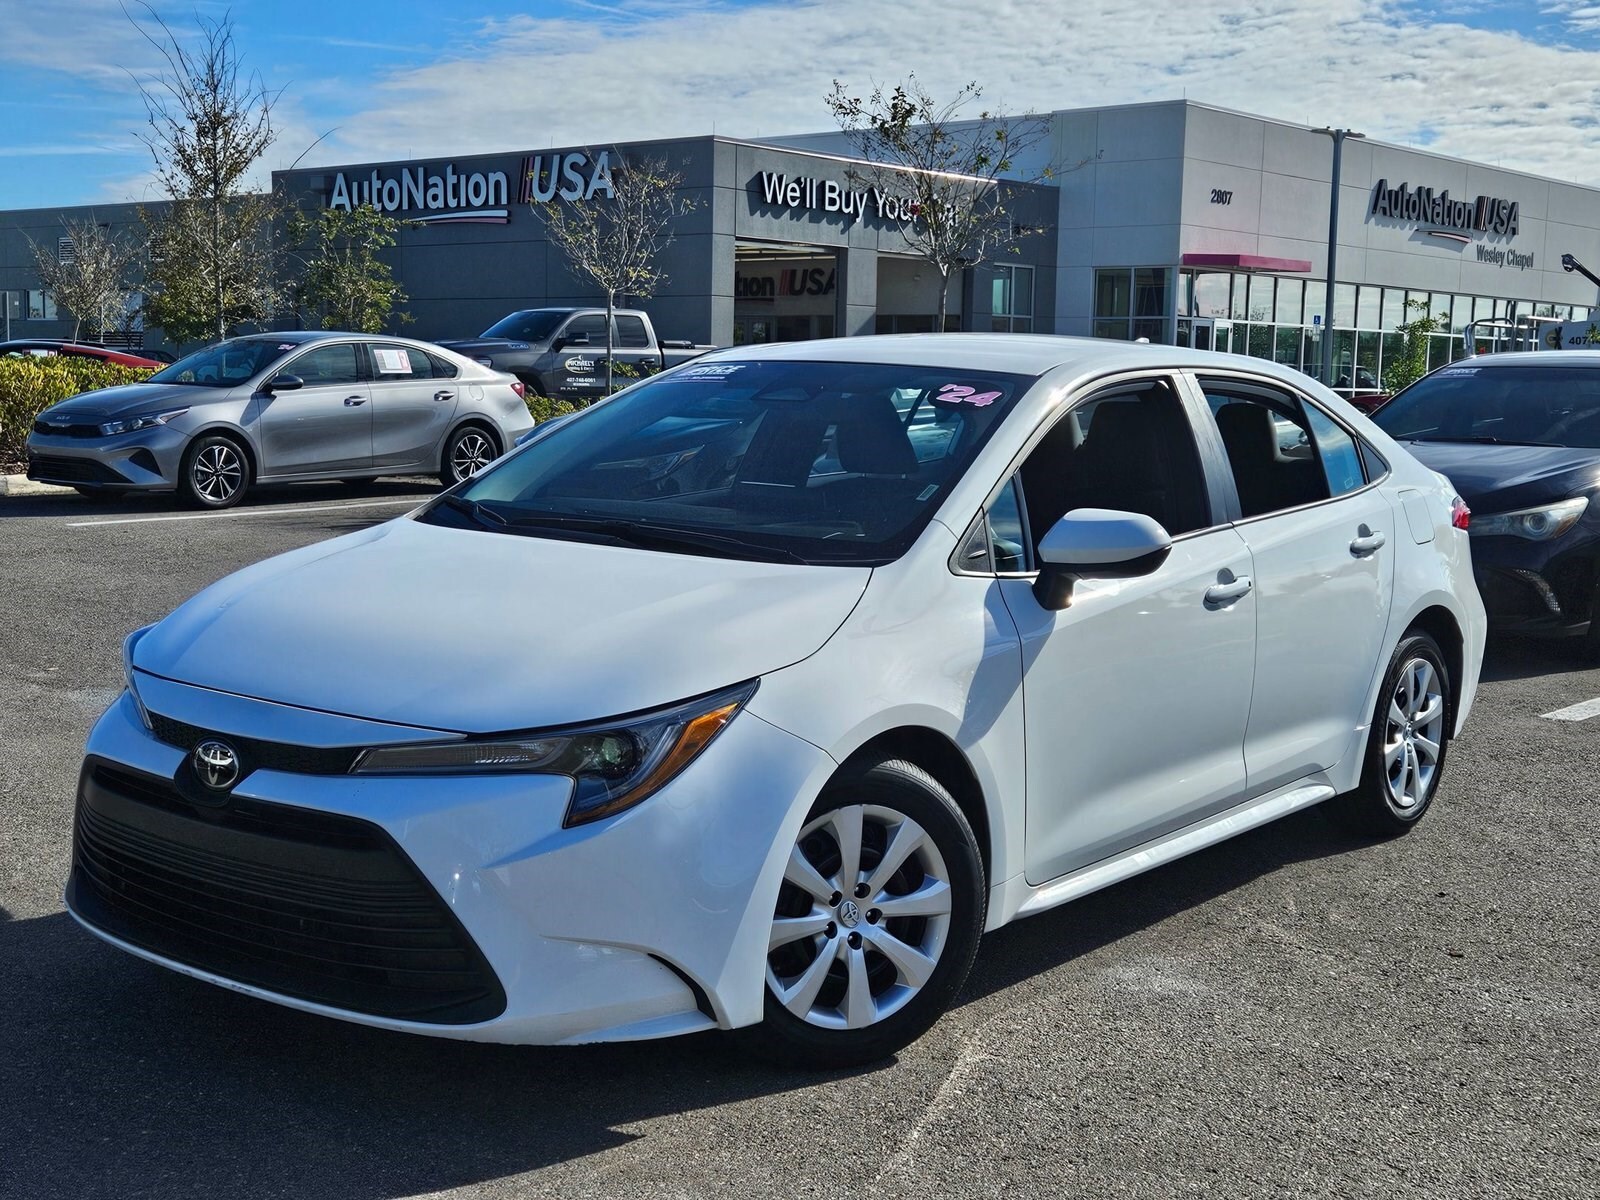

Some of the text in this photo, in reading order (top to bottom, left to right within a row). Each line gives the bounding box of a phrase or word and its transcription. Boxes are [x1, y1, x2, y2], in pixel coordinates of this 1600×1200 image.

[330, 151, 615, 212] AutoNation USA
[762, 171, 817, 209] We'll
[825, 180, 868, 222] Buy
[1210, 188, 1233, 205] 2807
[1373, 178, 1520, 236] AutoNation USA
[1476, 244, 1534, 271] Wesley Chapel
